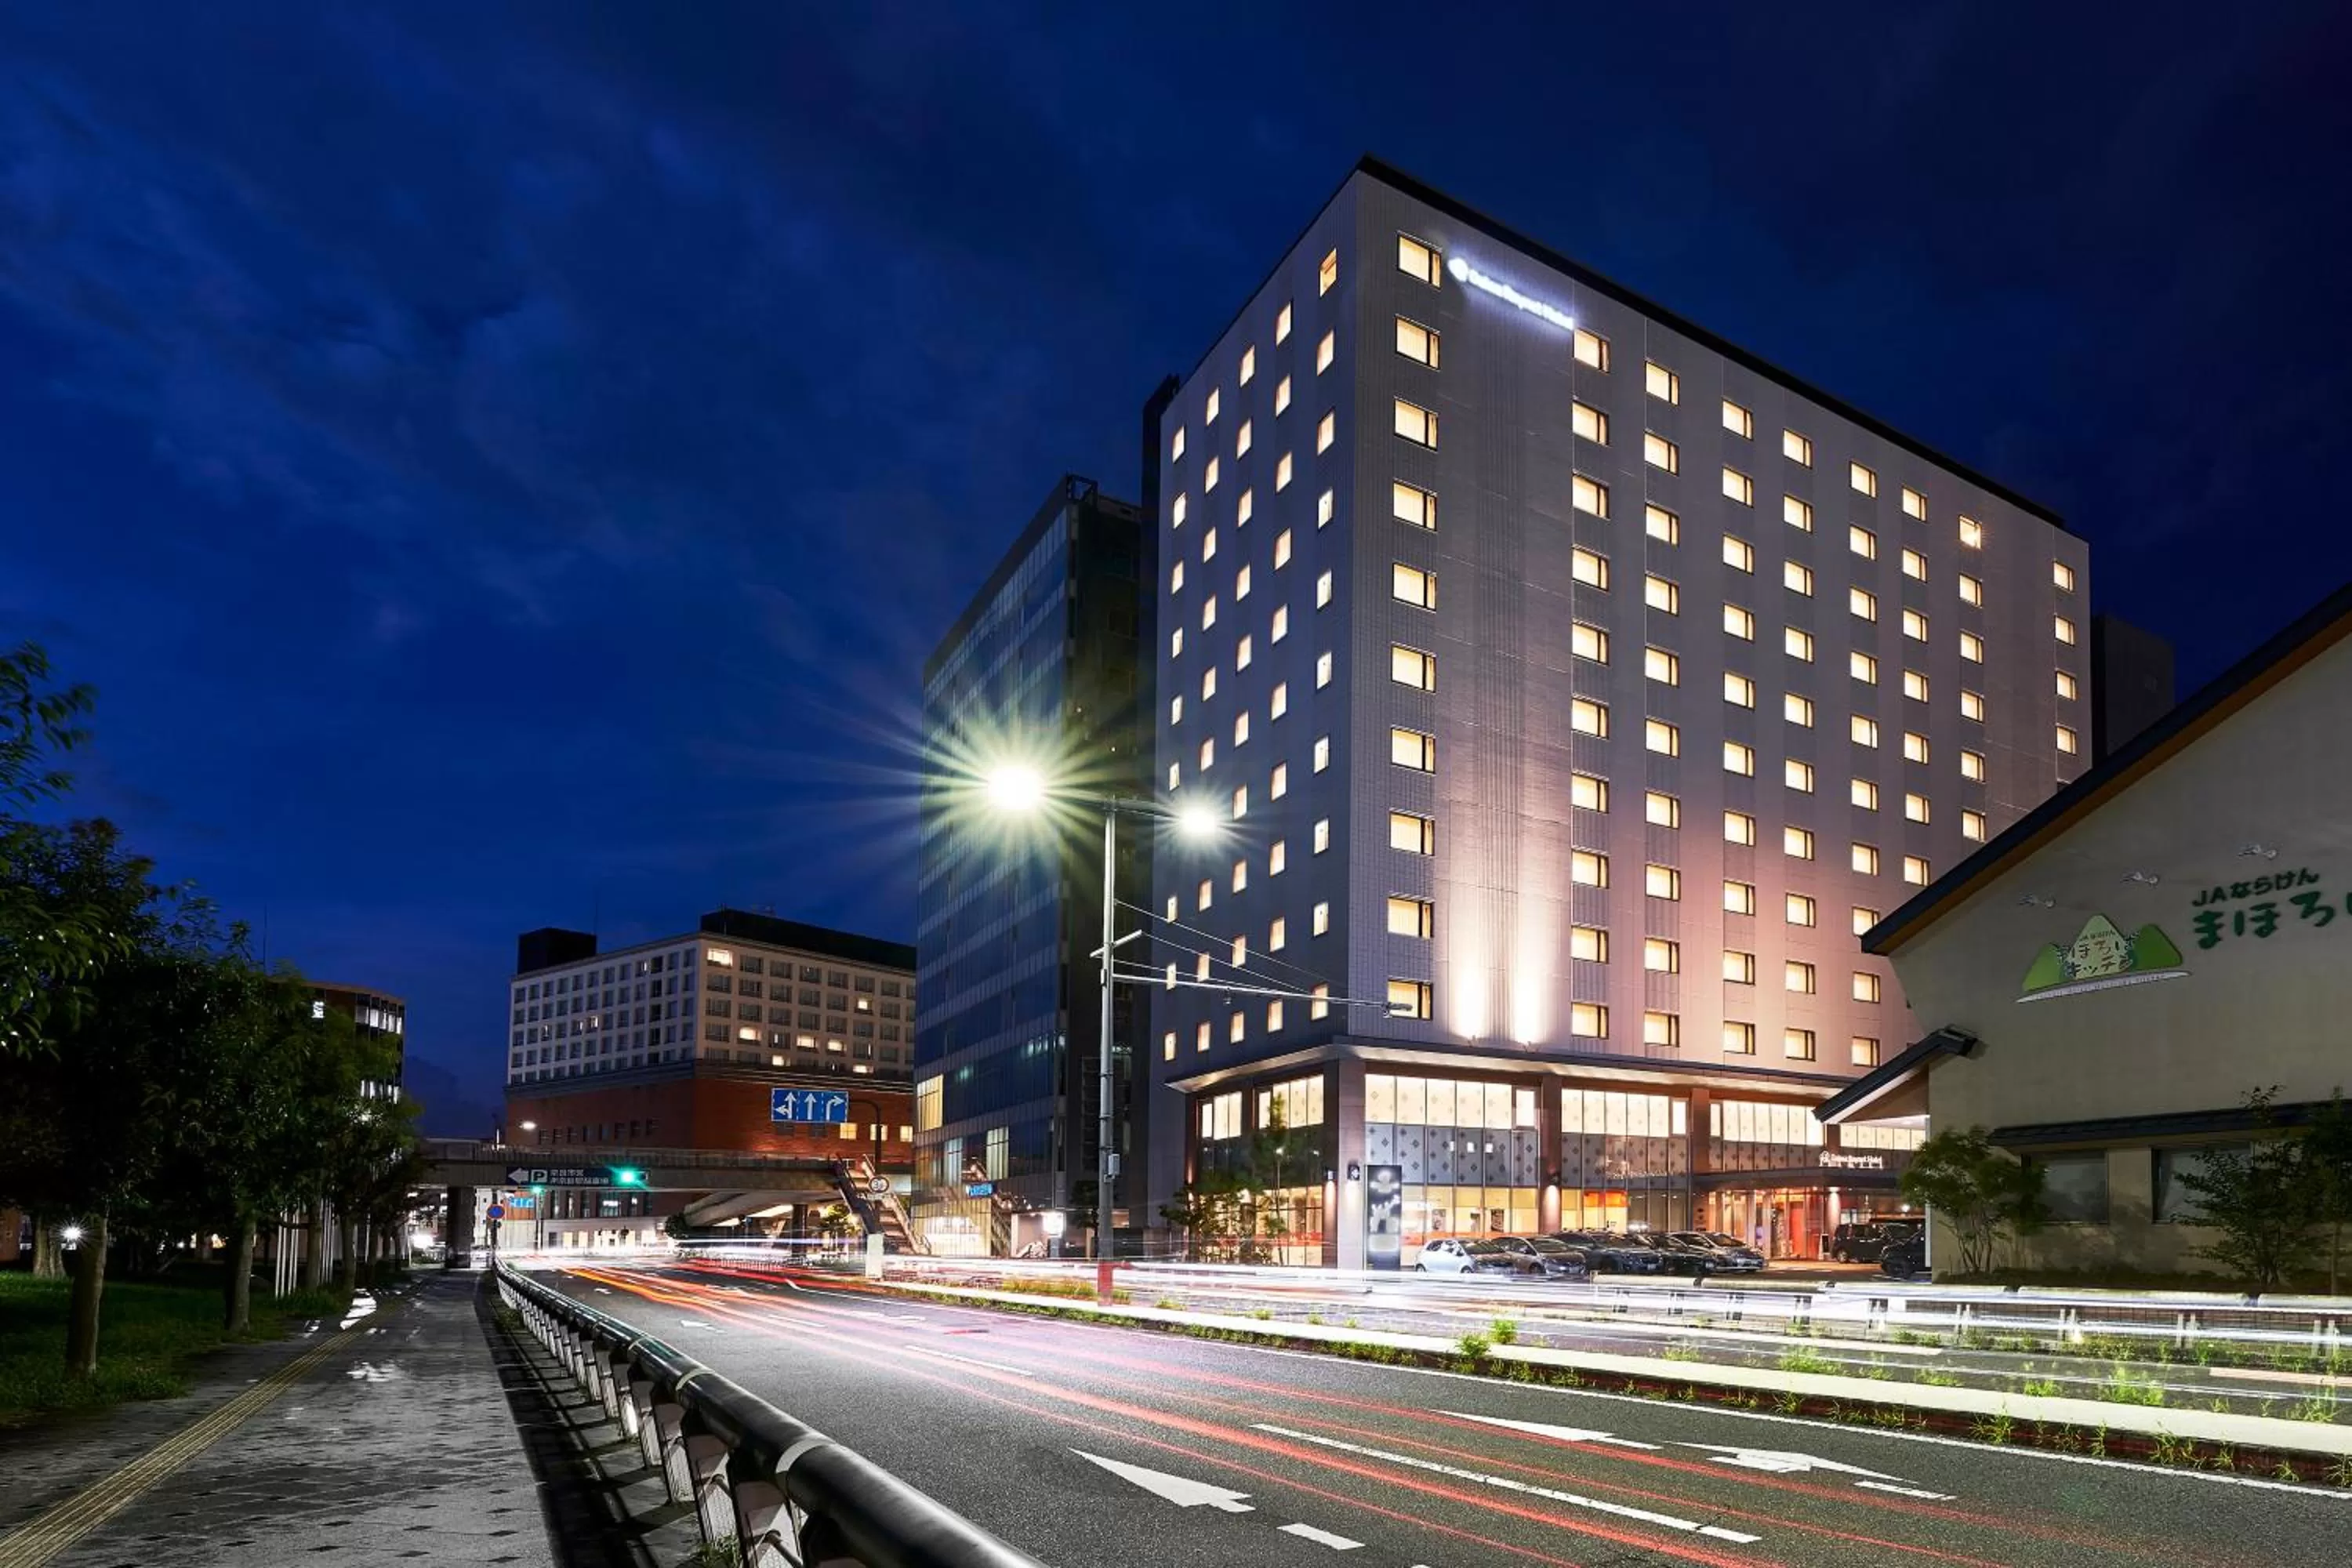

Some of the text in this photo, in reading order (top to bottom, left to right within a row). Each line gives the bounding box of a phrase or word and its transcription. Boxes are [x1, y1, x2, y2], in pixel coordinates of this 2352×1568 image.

[2192, 867, 2320, 906] JAならけん
[2193, 891, 2352, 949] まほろ
[533, 1171, 545, 1181] P
